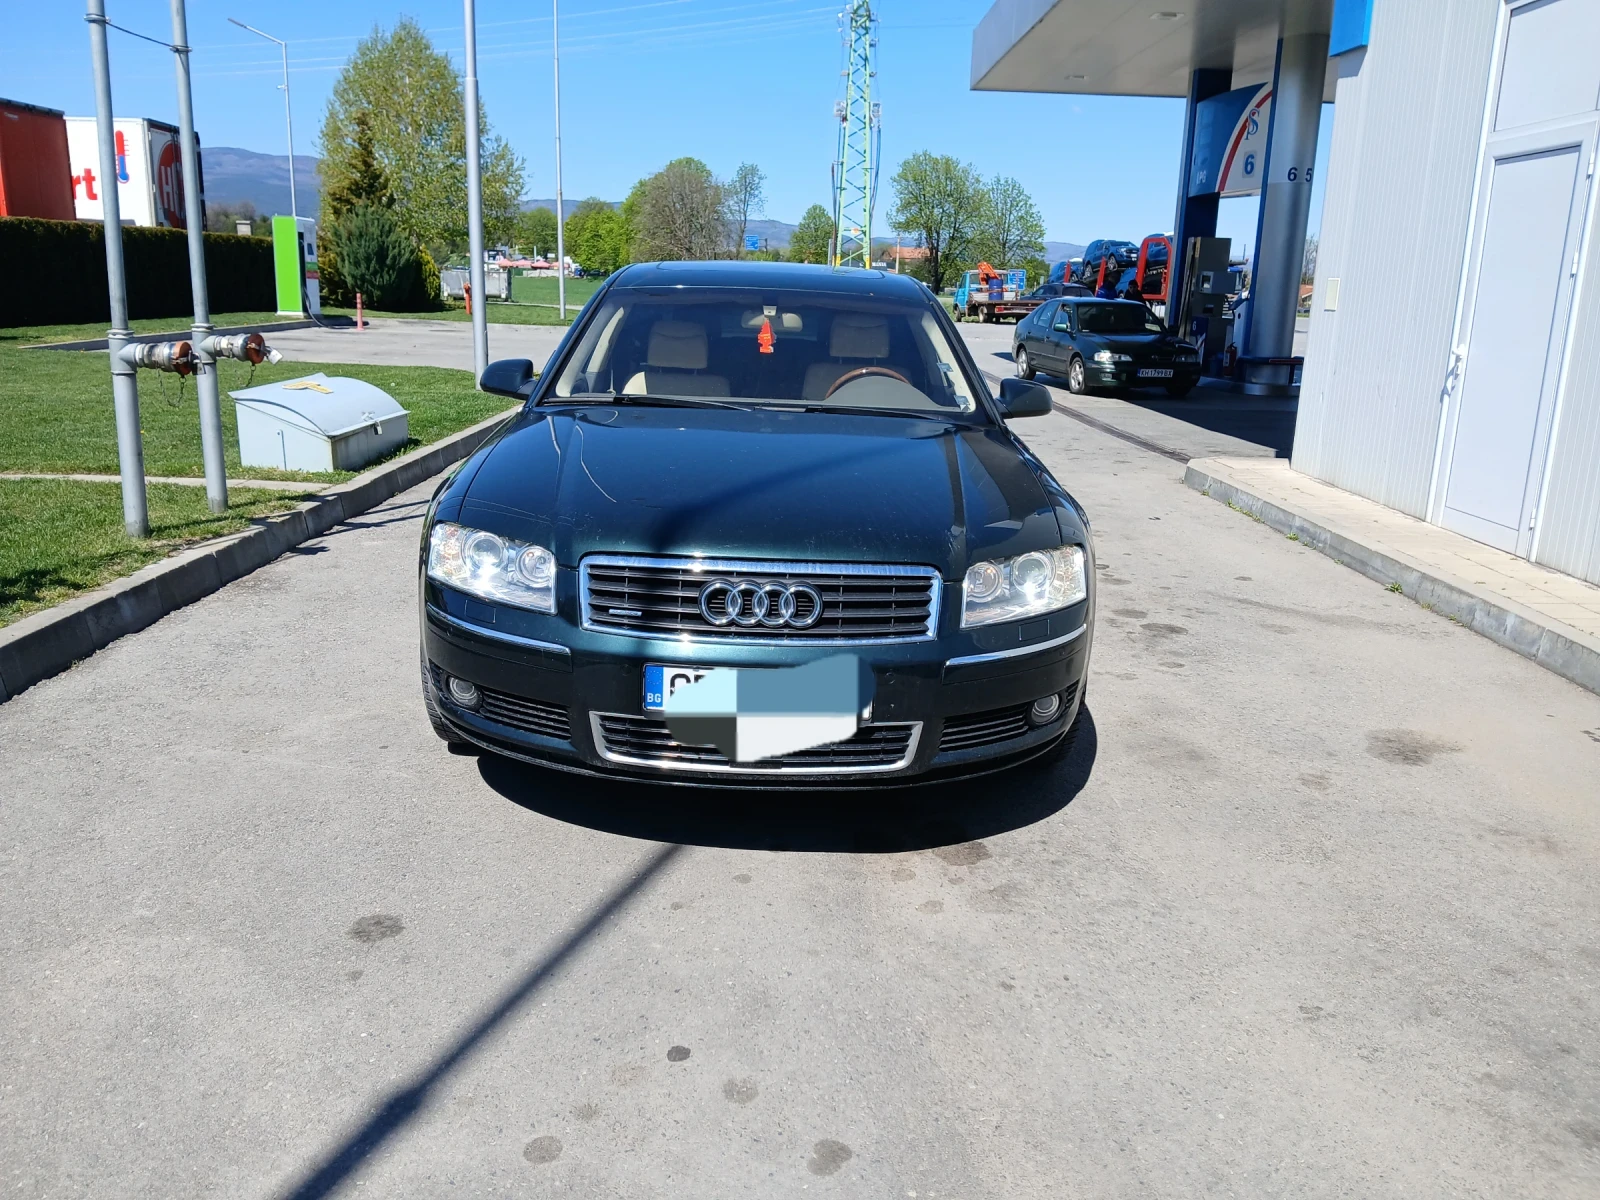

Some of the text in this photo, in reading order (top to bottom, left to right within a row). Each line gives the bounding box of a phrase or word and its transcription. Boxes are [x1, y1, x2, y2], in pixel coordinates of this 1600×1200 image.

[1244, 154, 1255, 175] 6
[1287, 167, 1313, 182] 6 5
[646, 692, 662, 703] BG
